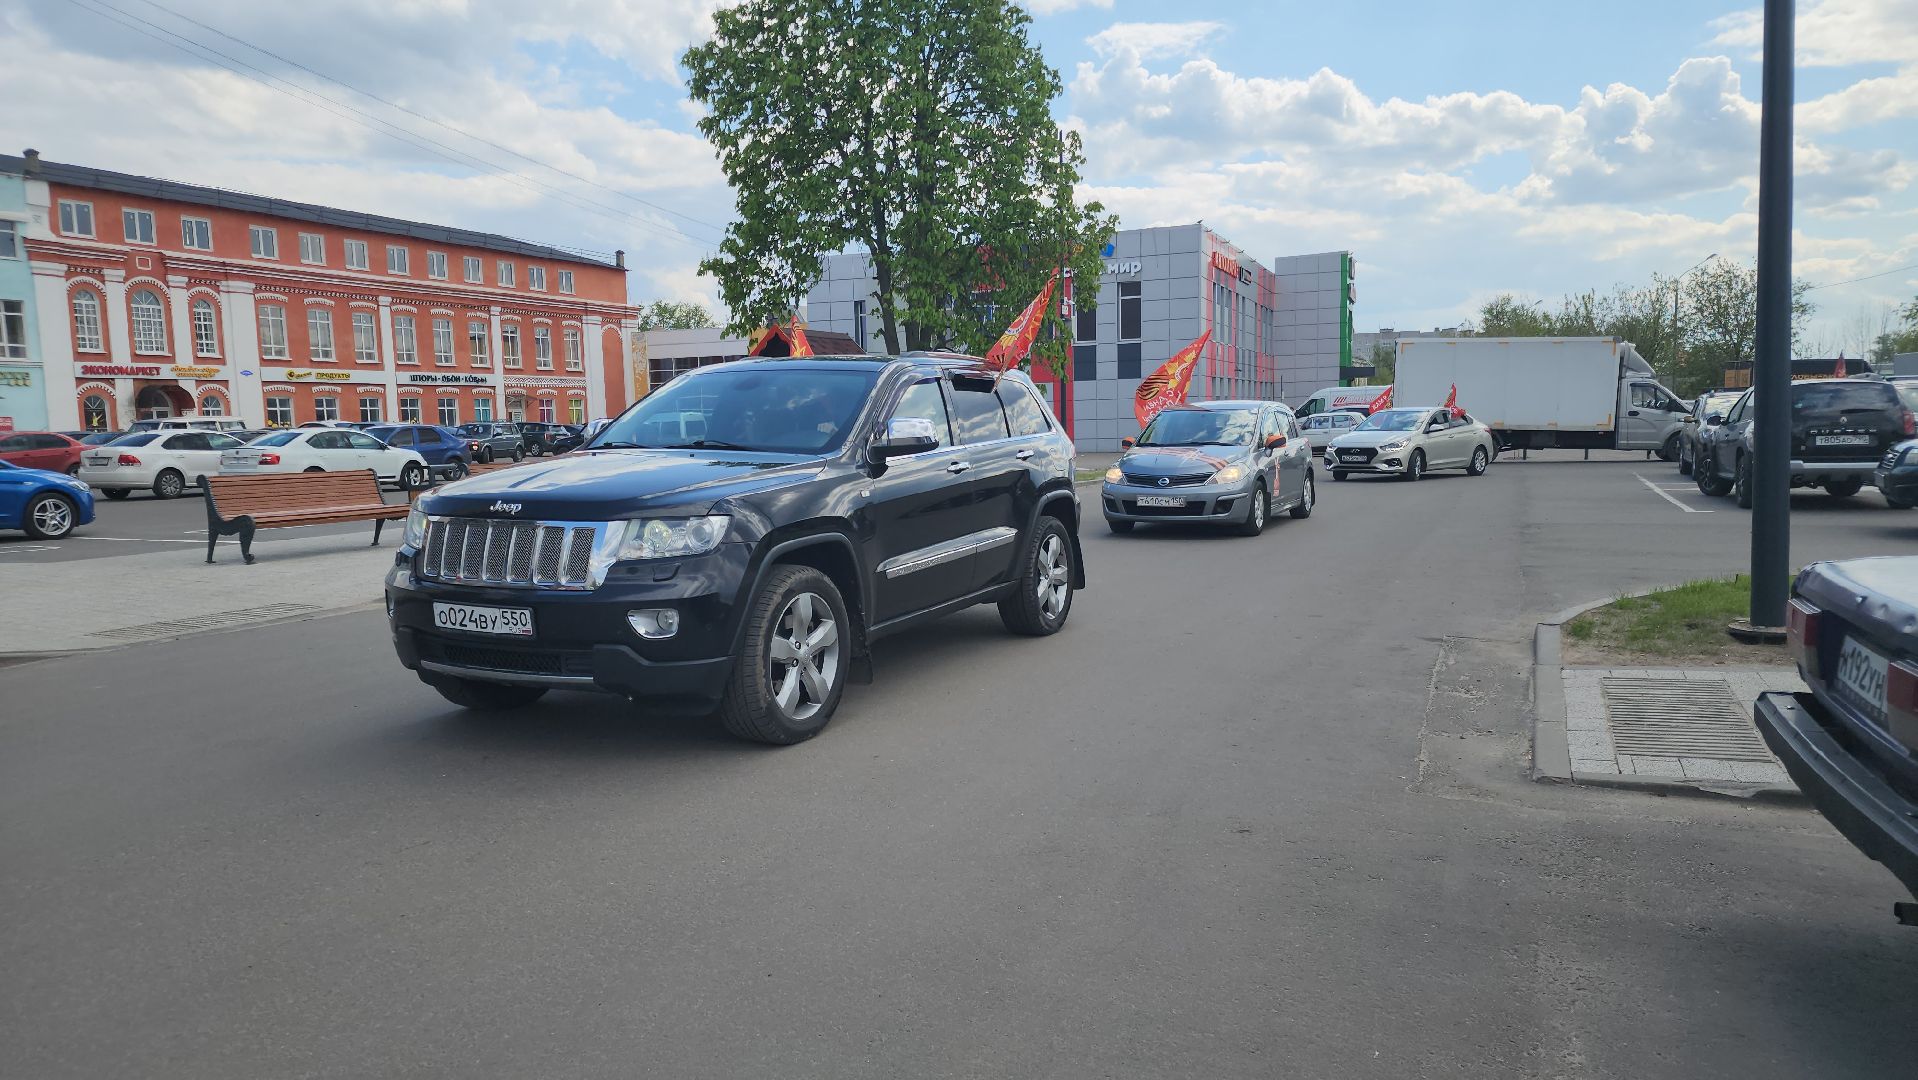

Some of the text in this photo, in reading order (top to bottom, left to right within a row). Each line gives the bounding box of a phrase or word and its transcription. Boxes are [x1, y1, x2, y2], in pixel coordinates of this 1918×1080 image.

[81, 365, 162, 376] ЭКОНОМАРКЕТ
[315, 372, 351, 380] ПРОДУКТЫ
[441, 374, 461, 383] ОБОИ
[490, 500, 521, 515] Jeep
